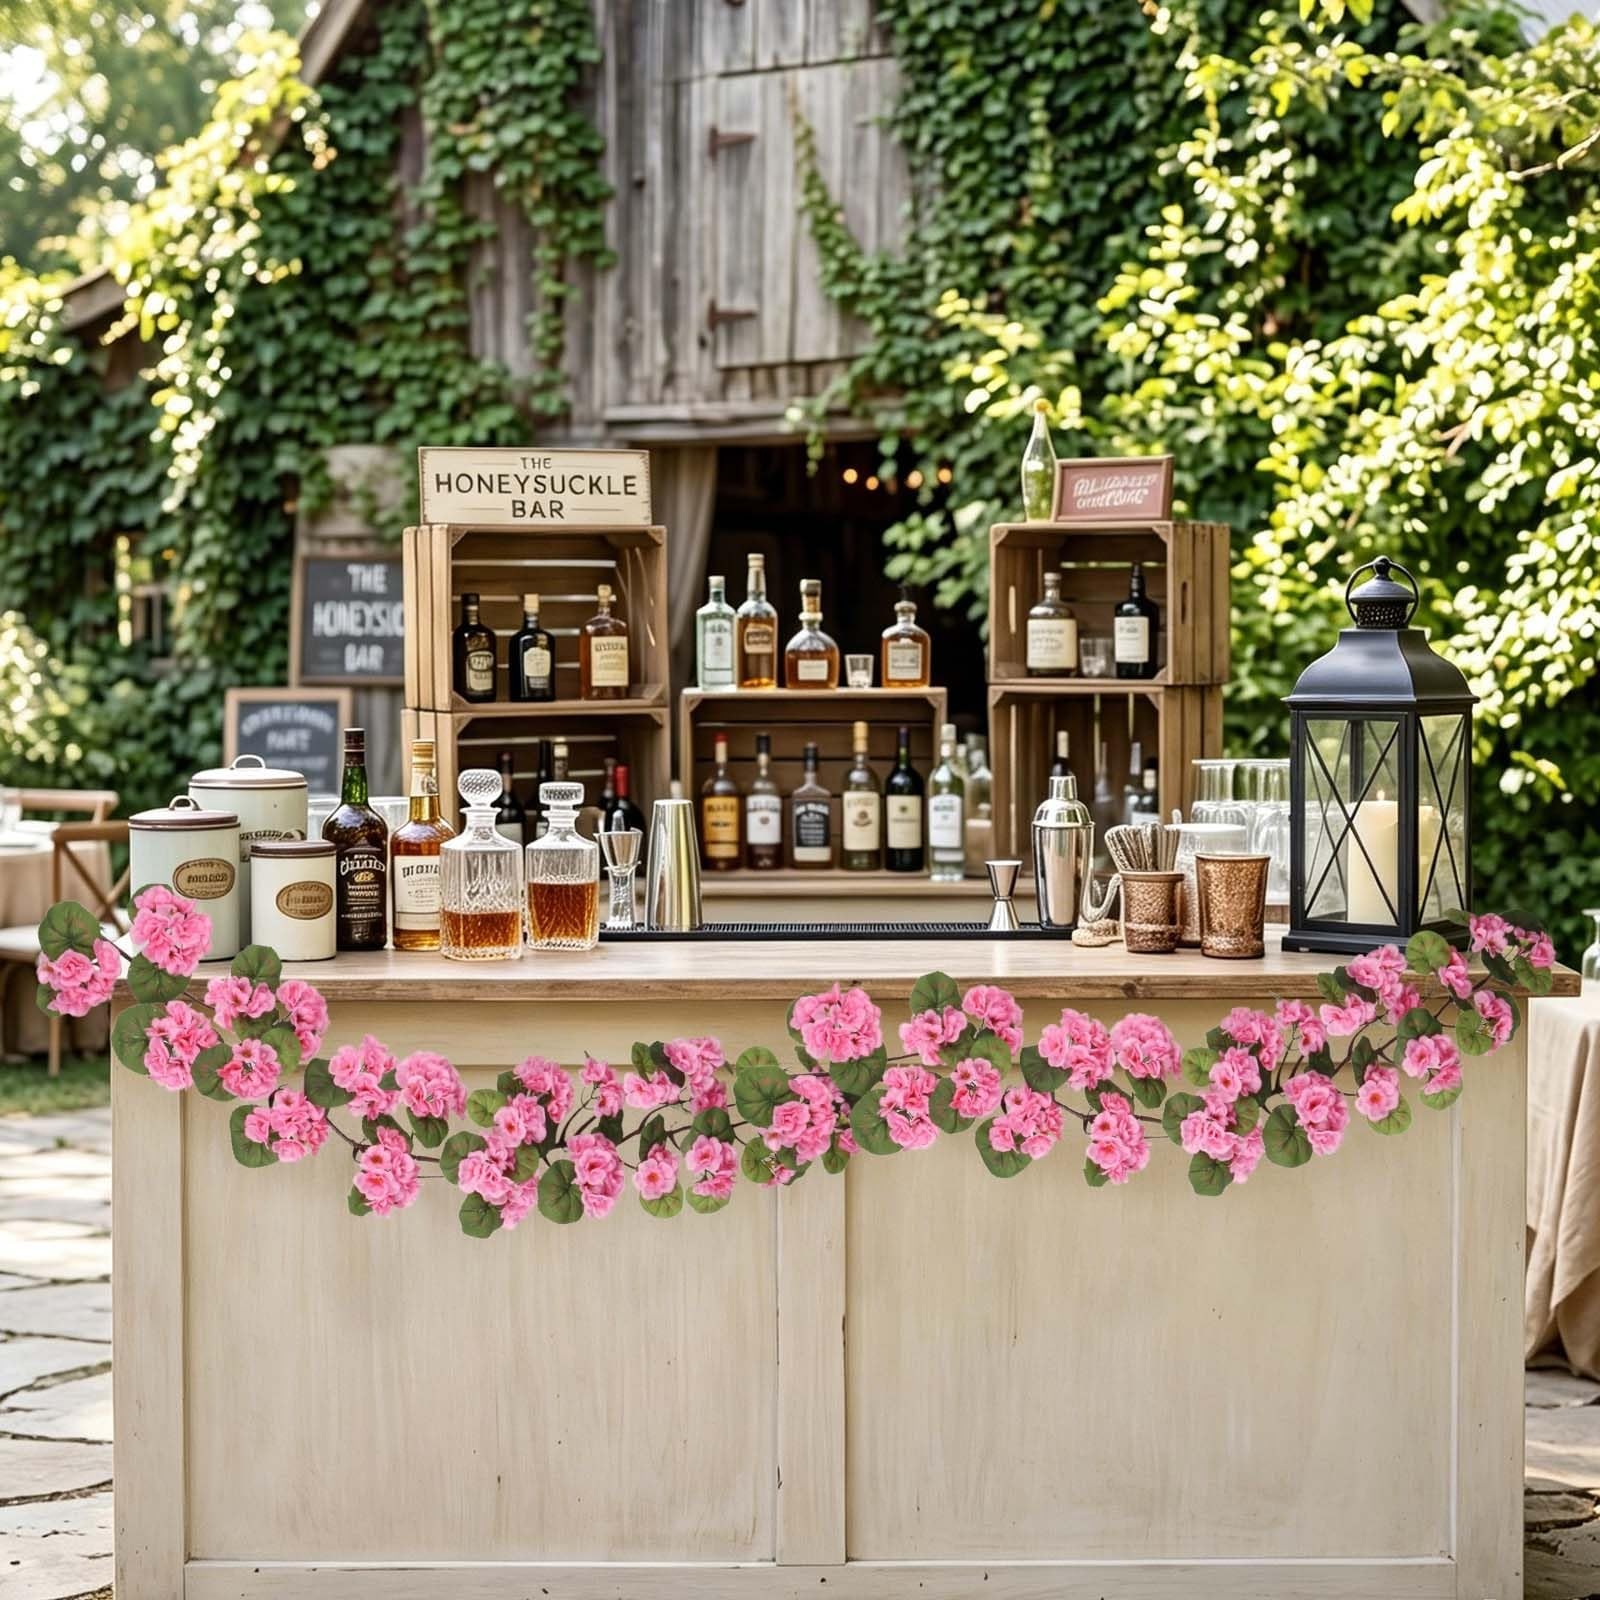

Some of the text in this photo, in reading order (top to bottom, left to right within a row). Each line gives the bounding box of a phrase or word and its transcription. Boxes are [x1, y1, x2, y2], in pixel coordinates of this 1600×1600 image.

[520, 457, 552, 470] THE
[435, 473, 638, 496] HONEYSUCKLE
[511, 499, 565, 519] BAR
[347, 564, 387, 593] THE
